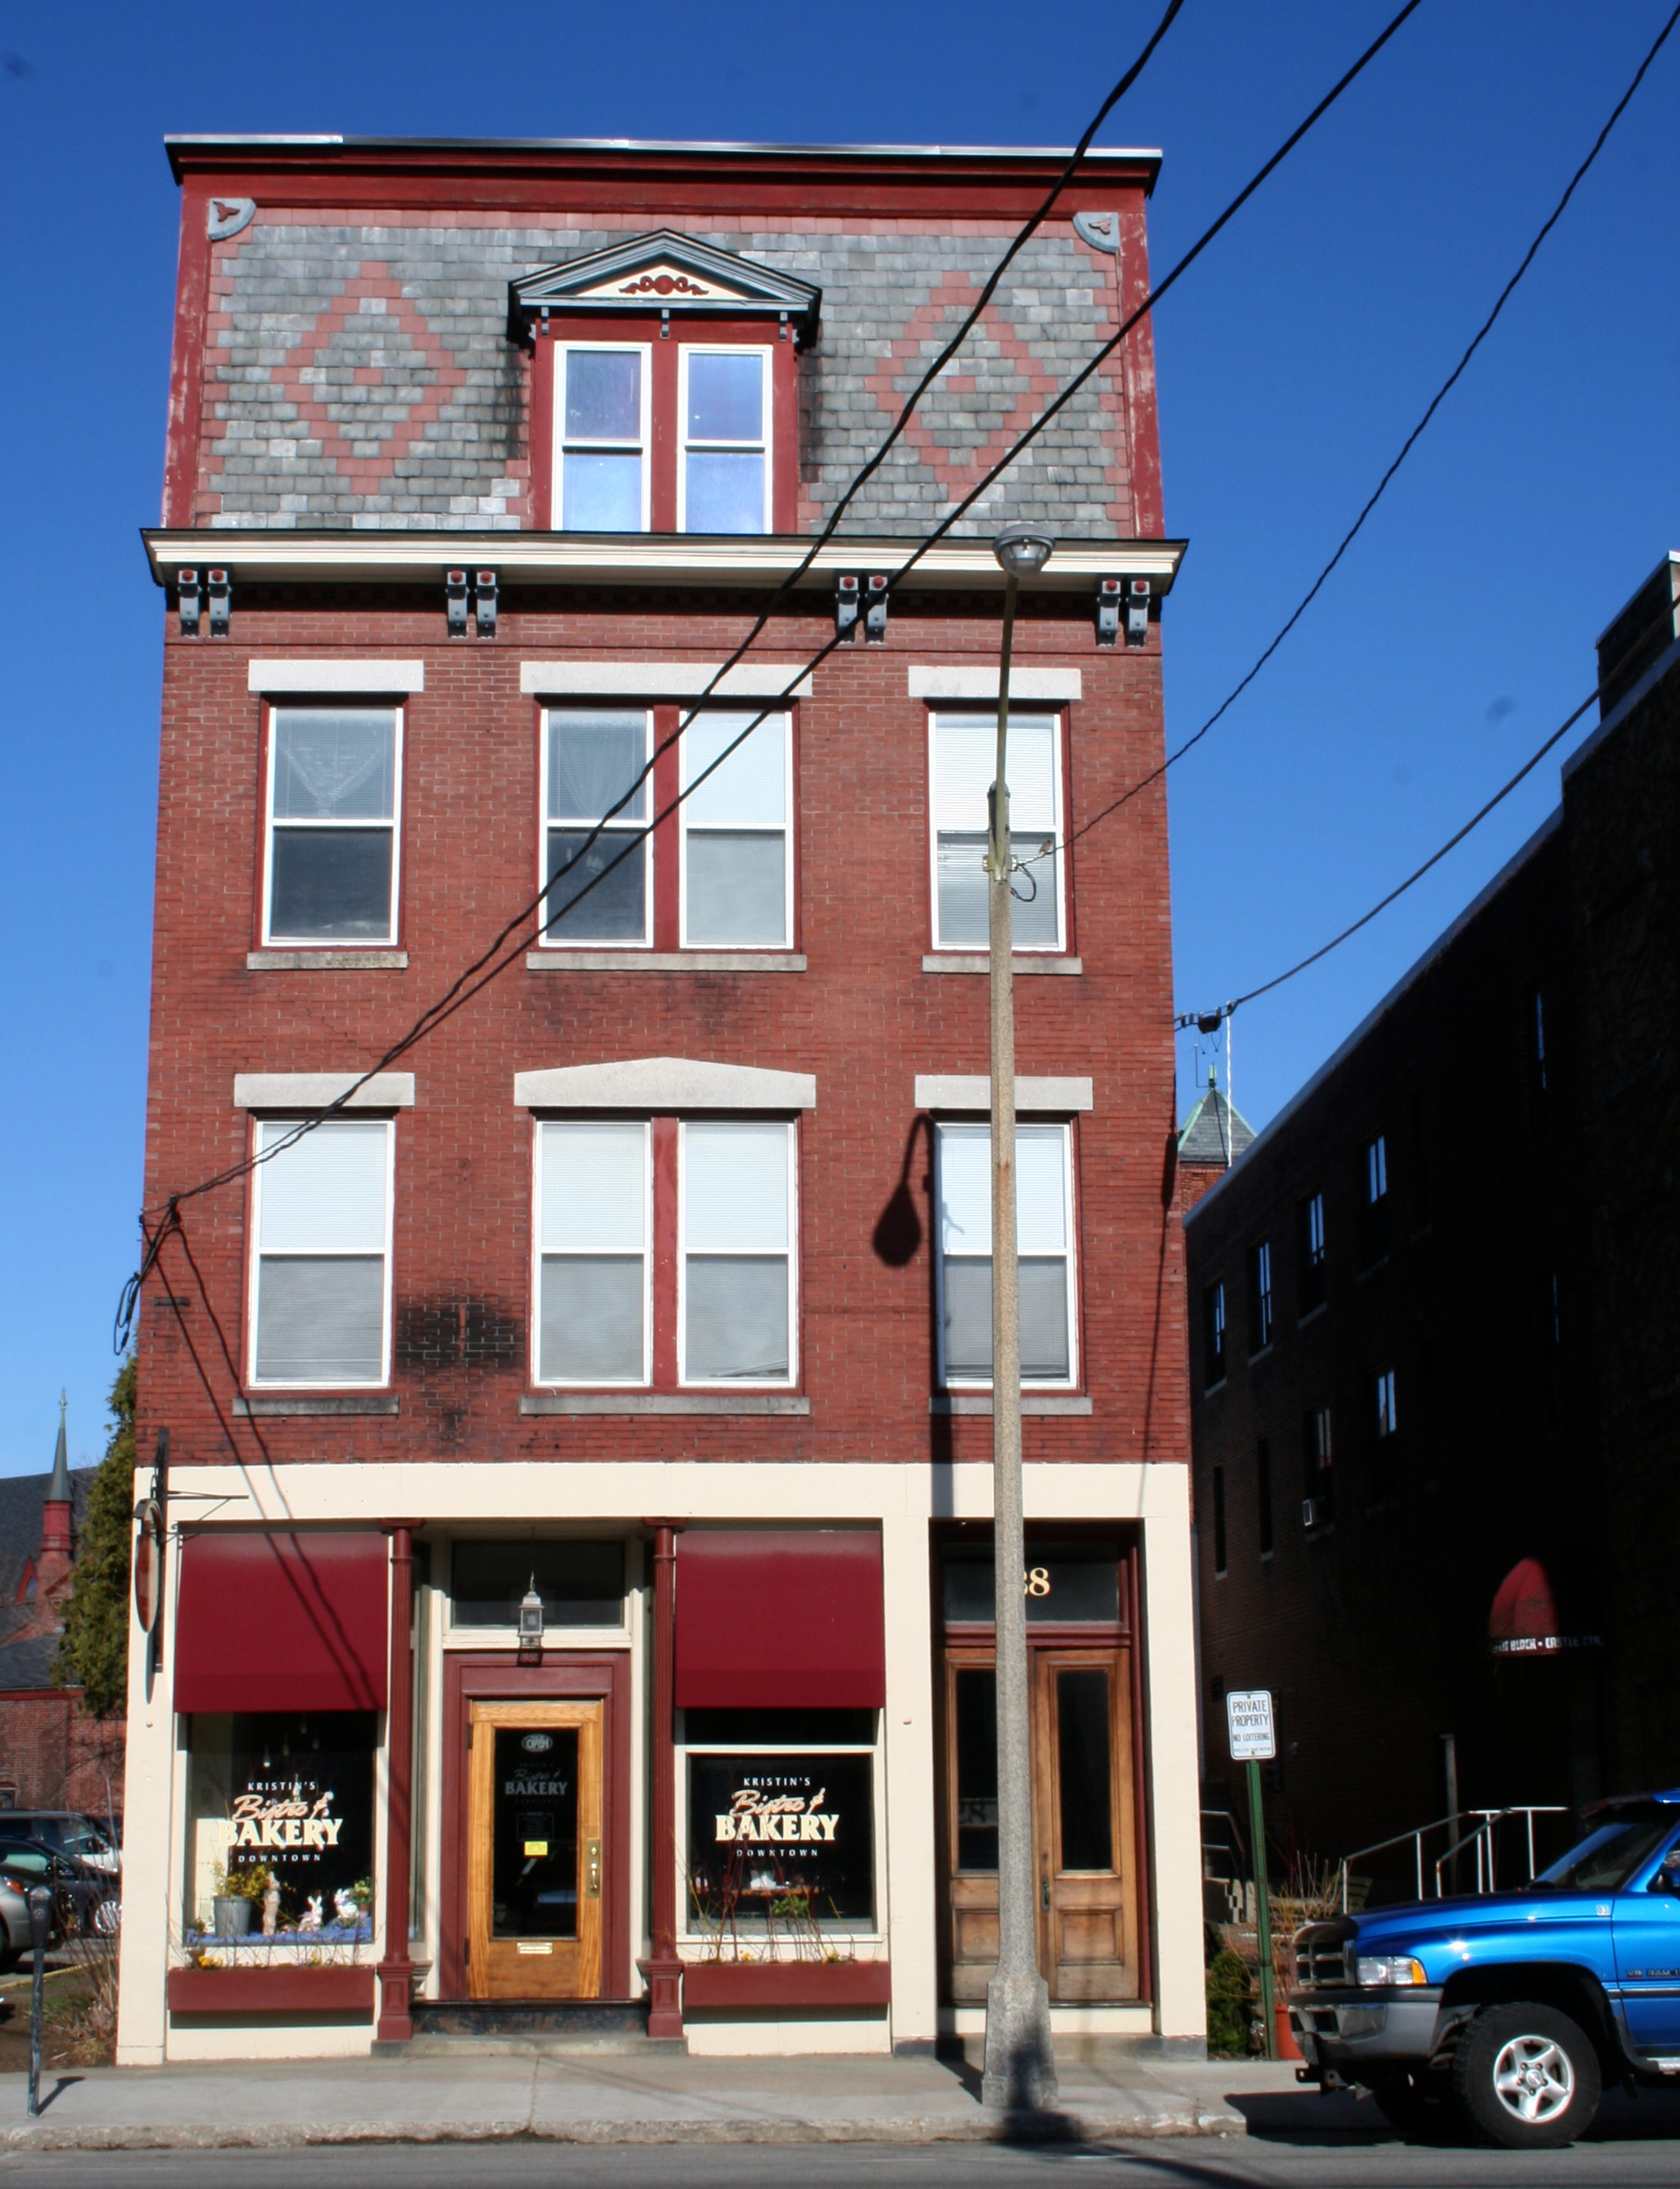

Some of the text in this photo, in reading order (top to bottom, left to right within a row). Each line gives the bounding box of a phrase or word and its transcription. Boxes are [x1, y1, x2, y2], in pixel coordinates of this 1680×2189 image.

[1024, 1567, 1051, 1596] 8
[1232, 1701, 1267, 1713] PRIVATE
[1232, 1714, 1269, 1727] PROPERTY
[1242, 1732, 1270, 1742] LOITERING
[248, 1781, 316, 1791] KRISTIN'S
[505, 1781, 568, 1795] BAKERY
[743, 1777, 811, 1786] KRISTIN'S
[232, 1795, 309, 1822] Bistro
[729, 1789, 806, 1818] Bistro
[216, 1818, 344, 1847] BAKERY
[715, 1815, 840, 1842] BAKERY
[736, 1849, 817, 1858] DOWNTOWN
